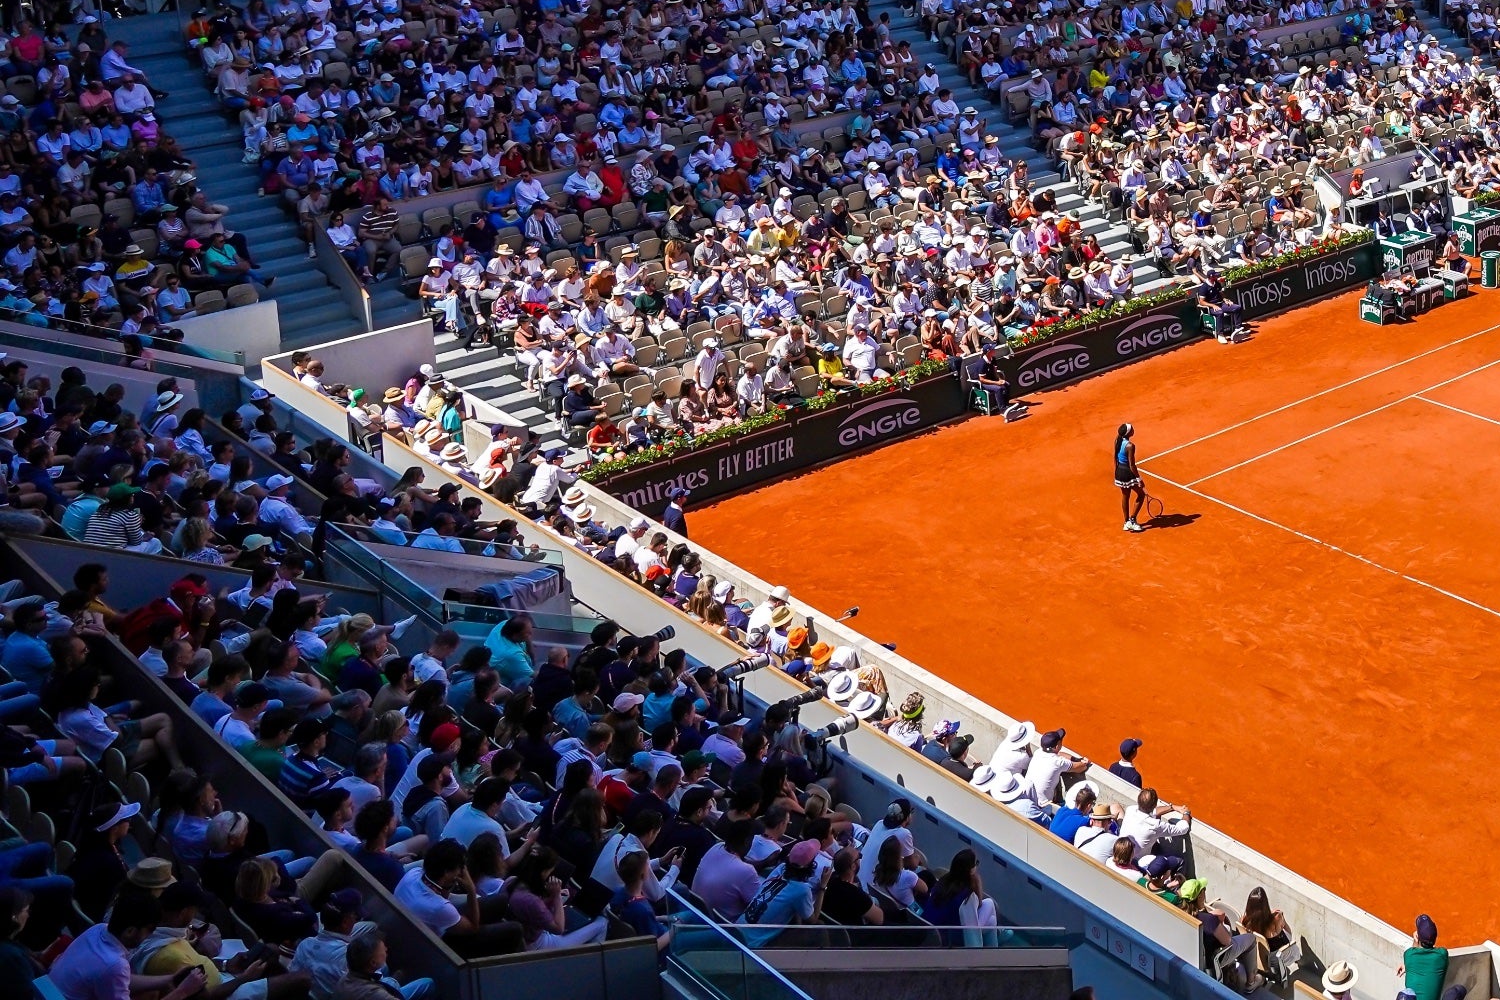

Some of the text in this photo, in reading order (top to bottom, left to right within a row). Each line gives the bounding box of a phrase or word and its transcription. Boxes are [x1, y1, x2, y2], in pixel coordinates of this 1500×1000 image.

[1304, 257, 1357, 290] Infosys
[1236, 277, 1292, 311] Infosys
[611, 436, 794, 509] mirates FLY BETTER
